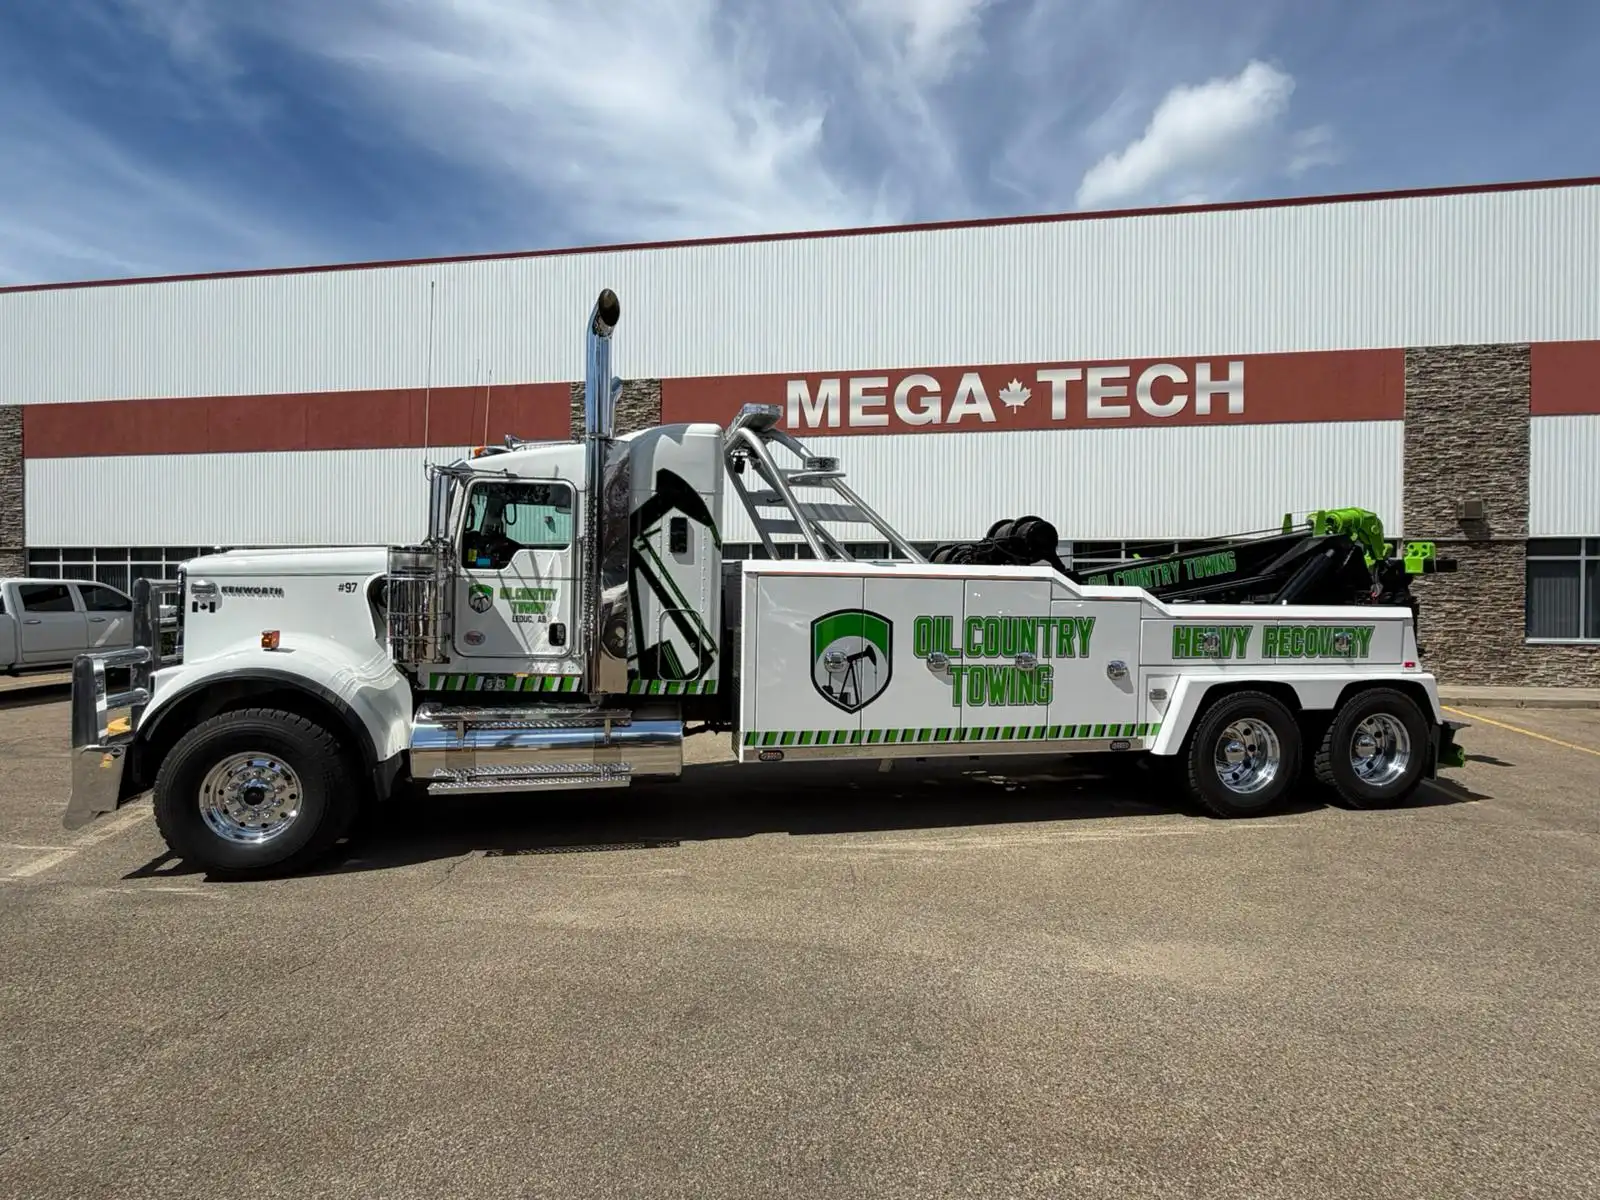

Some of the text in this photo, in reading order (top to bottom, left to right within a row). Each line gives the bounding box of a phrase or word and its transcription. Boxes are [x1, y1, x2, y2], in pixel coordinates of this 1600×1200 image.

[787, 361, 1244, 429] MEGA TECH
[1183, 551, 1237, 580] TOWING
[221, 586, 283, 596] KENWORTH
[337, 582, 358, 593] #97
[913, 616, 1096, 659] OIL COUNTRY
[948, 664, 1054, 707] TOWING
